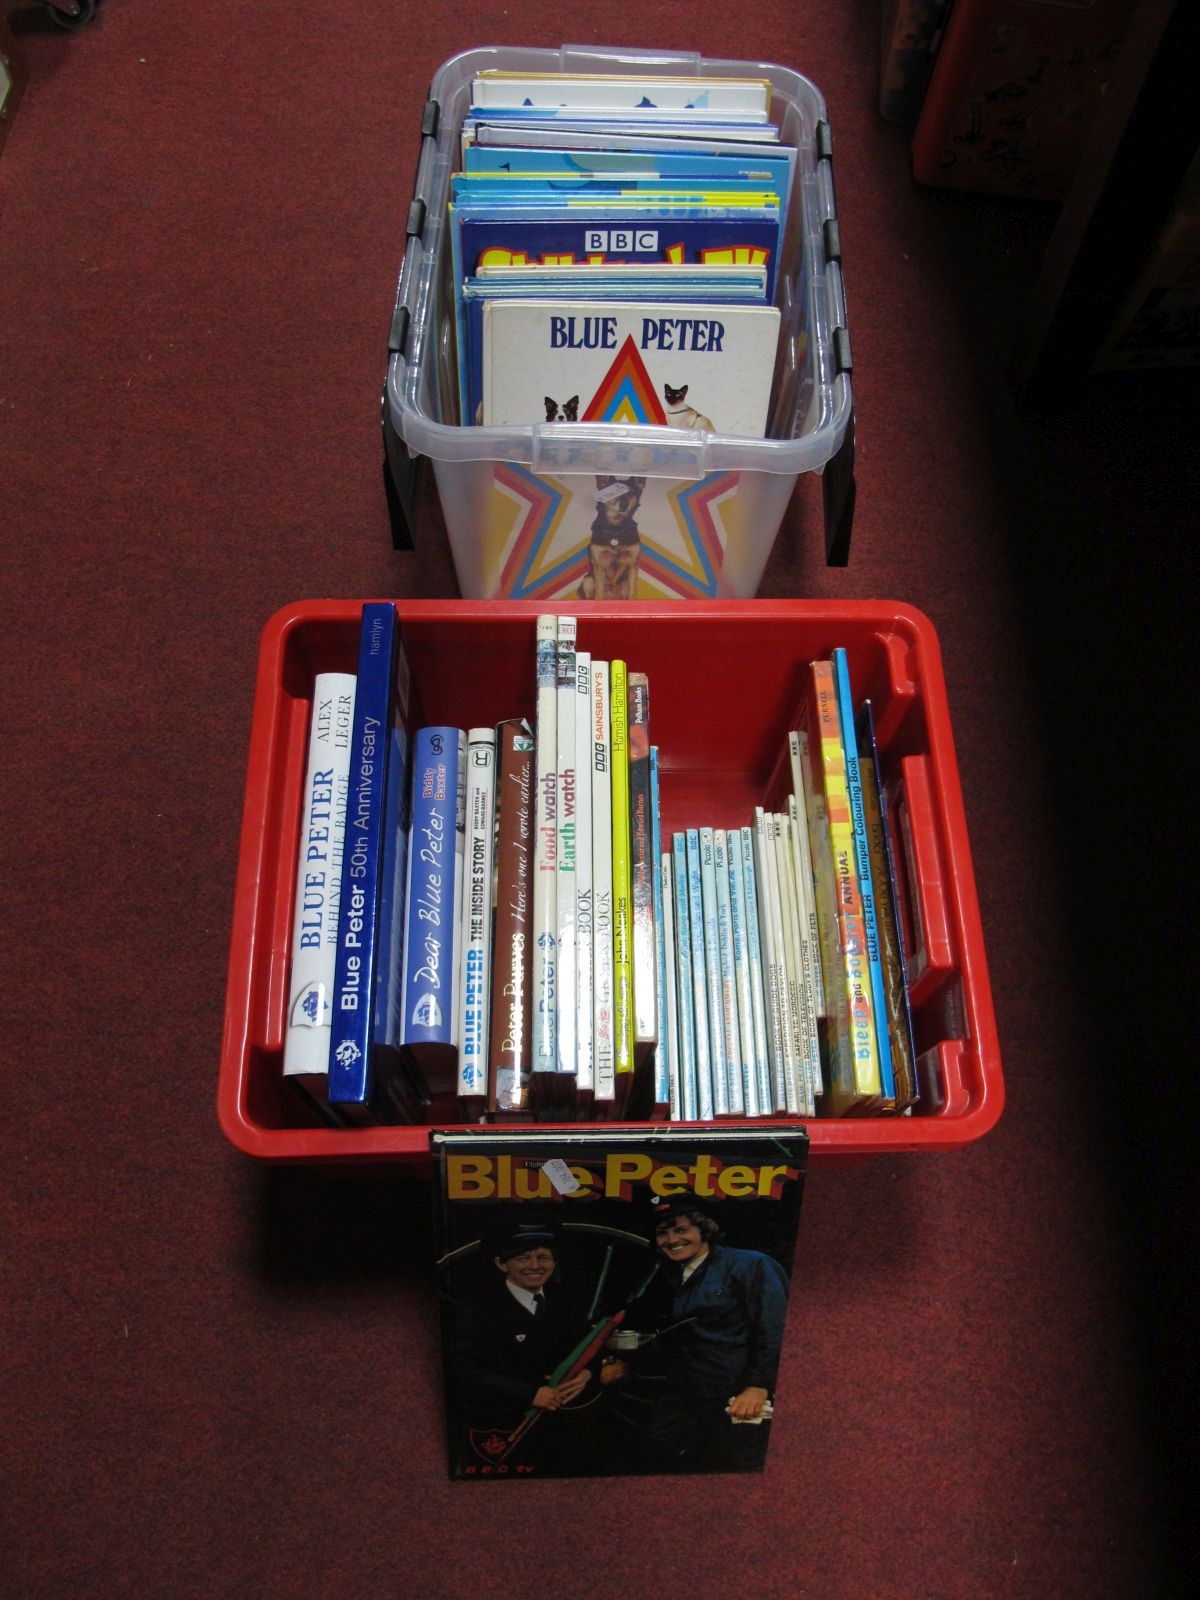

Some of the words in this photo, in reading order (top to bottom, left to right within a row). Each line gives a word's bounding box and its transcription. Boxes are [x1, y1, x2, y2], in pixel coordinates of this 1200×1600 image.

[588, 231, 658, 251] BBC
[550, 316, 617, 349] BLUE
[641, 318, 725, 352] PETER
[368, 618, 385, 656] hamlyn
[576, 665, 589, 695] BBC
[611, 672, 625, 715] Hamilton
[632, 686, 643, 704] Books
[316, 698, 333, 743] ALEX
[334, 694, 353, 749] LEGER
[593, 671, 606, 741] SAINSBURY'S
[633, 704, 644, 724] Pelham
[819, 690, 831, 723] PURNELL
[611, 716, 625, 752] Hamish
[353, 717, 381, 831] Anniversary
[594, 742, 607, 773] BBC
[848, 756, 860, 785] Book
[421, 767, 436, 800] Biddy
[433, 763, 448, 801] Baxter
[539, 772, 557, 822] watch
[558, 768, 577, 818] watch
[305, 768, 334, 863] PETER
[333, 775, 350, 829] BADGE
[852, 786, 868, 836] Colouring
[420, 807, 445, 868] Peter
[516, 807, 530, 840] wrote
[742, 829, 750, 840] BBC
[332, 835, 346, 870] THE
[350, 837, 369, 878] 50th
[471, 835, 487, 874] STORY
[539, 826, 557, 873] Food
[557, 822, 577, 873] Earth
[689, 836, 698, 850] BBC
[703, 844, 712, 866] Piccolo
[743, 843, 751, 861] Piccolo
[857, 838, 870, 880] Bumper
[517, 856, 528, 878] one
[300, 872, 327, 950] BLUE
[326, 877, 342, 945] BEHIND
[417, 874, 443, 926] Blue
[470, 875, 485, 917] INSIDE
[509, 882, 528, 923] Here's
[862, 894, 876, 930] PETER
[344, 885, 366, 949] Peter
[469, 919, 484, 942] THE
[613, 896, 629, 938] Noakes
[808, 912, 816, 930] PETS
[810, 931, 818, 941] OF
[413, 932, 443, 990] Dear
[503, 933, 526, 998] Purves
[615, 939, 631, 966] John
[801, 939, 810, 971] CLOTHES
[812, 942, 820, 964] BOOK
[867, 932, 880, 962] BLUE
[340, 956, 362, 1010] Blue
[466, 949, 485, 1005] PETER
[539, 958, 555, 1014] Peter
[768, 963, 777, 987] DOGS
[798, 983, 807, 1024] TELEVISION
[808, 1004, 815, 1015] OF
[464, 1009, 483, 1056] BLUE
[501, 1003, 524, 1054] Peter
[774, 1029, 782, 1051] BOOK
[793, 1031, 801, 1057] SAFARI
[802, 1025, 809, 1036] OF
[852, 1009, 871, 1060] Bleep
[598, 1046, 614, 1084] THE
[447, 1153, 594, 1200] Blue
[605, 1153, 787, 1199] Peter
